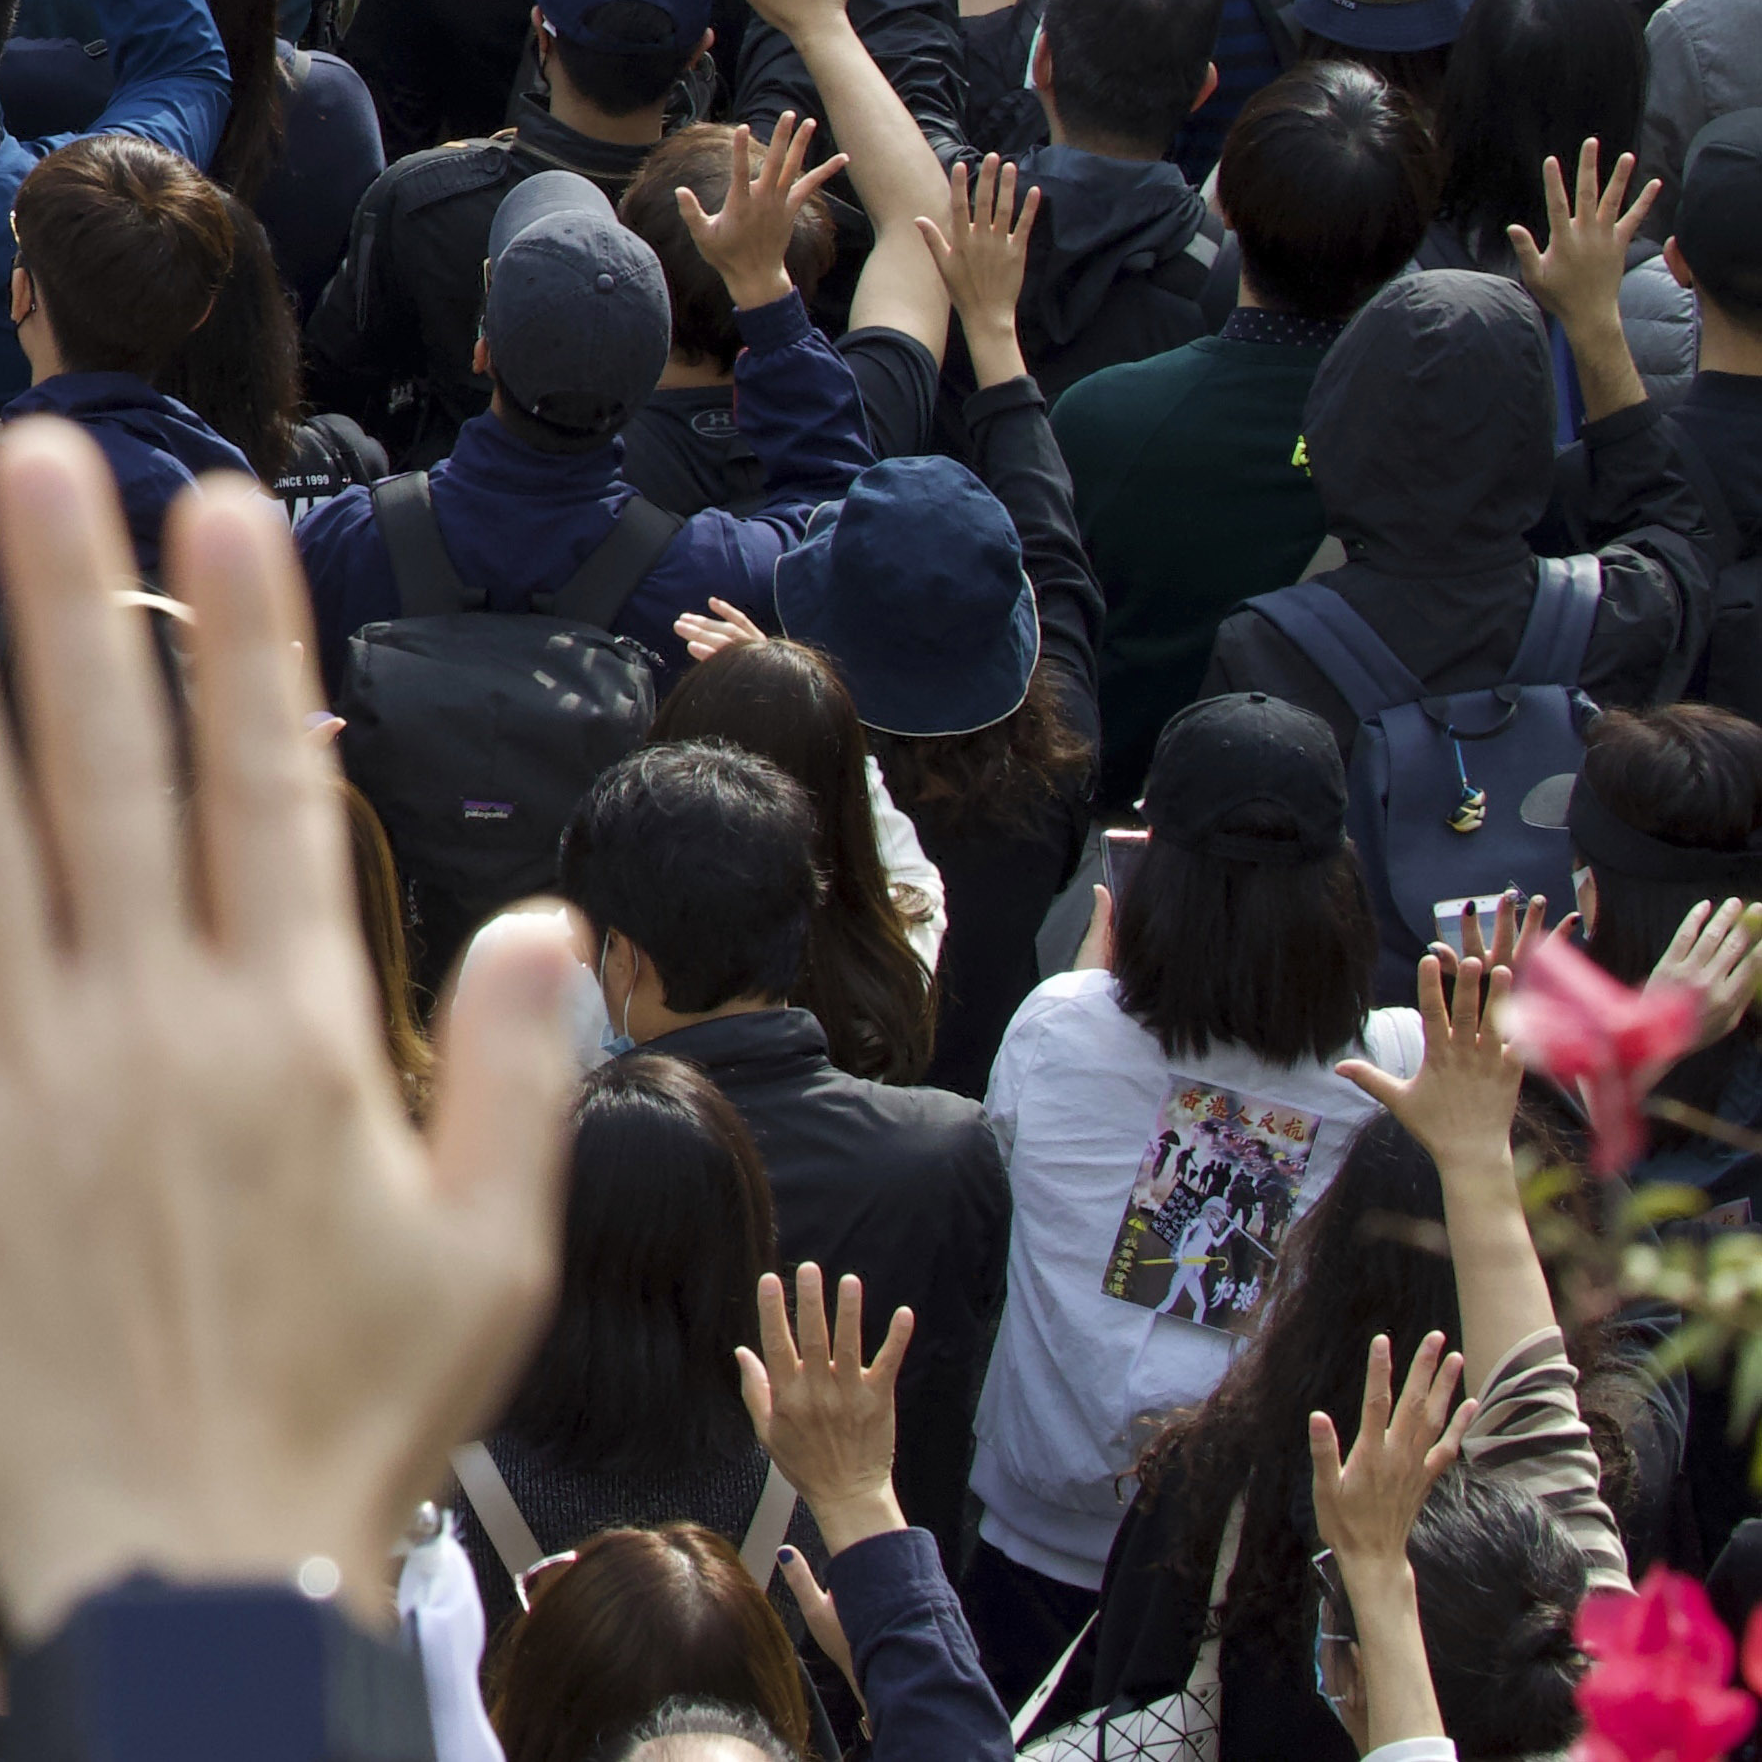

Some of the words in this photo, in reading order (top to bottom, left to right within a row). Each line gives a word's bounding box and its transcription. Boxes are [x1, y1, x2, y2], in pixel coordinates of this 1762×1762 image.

[305, 474, 330, 486] 1999
[1180, 1089, 1306, 1142] 香港人反抗
